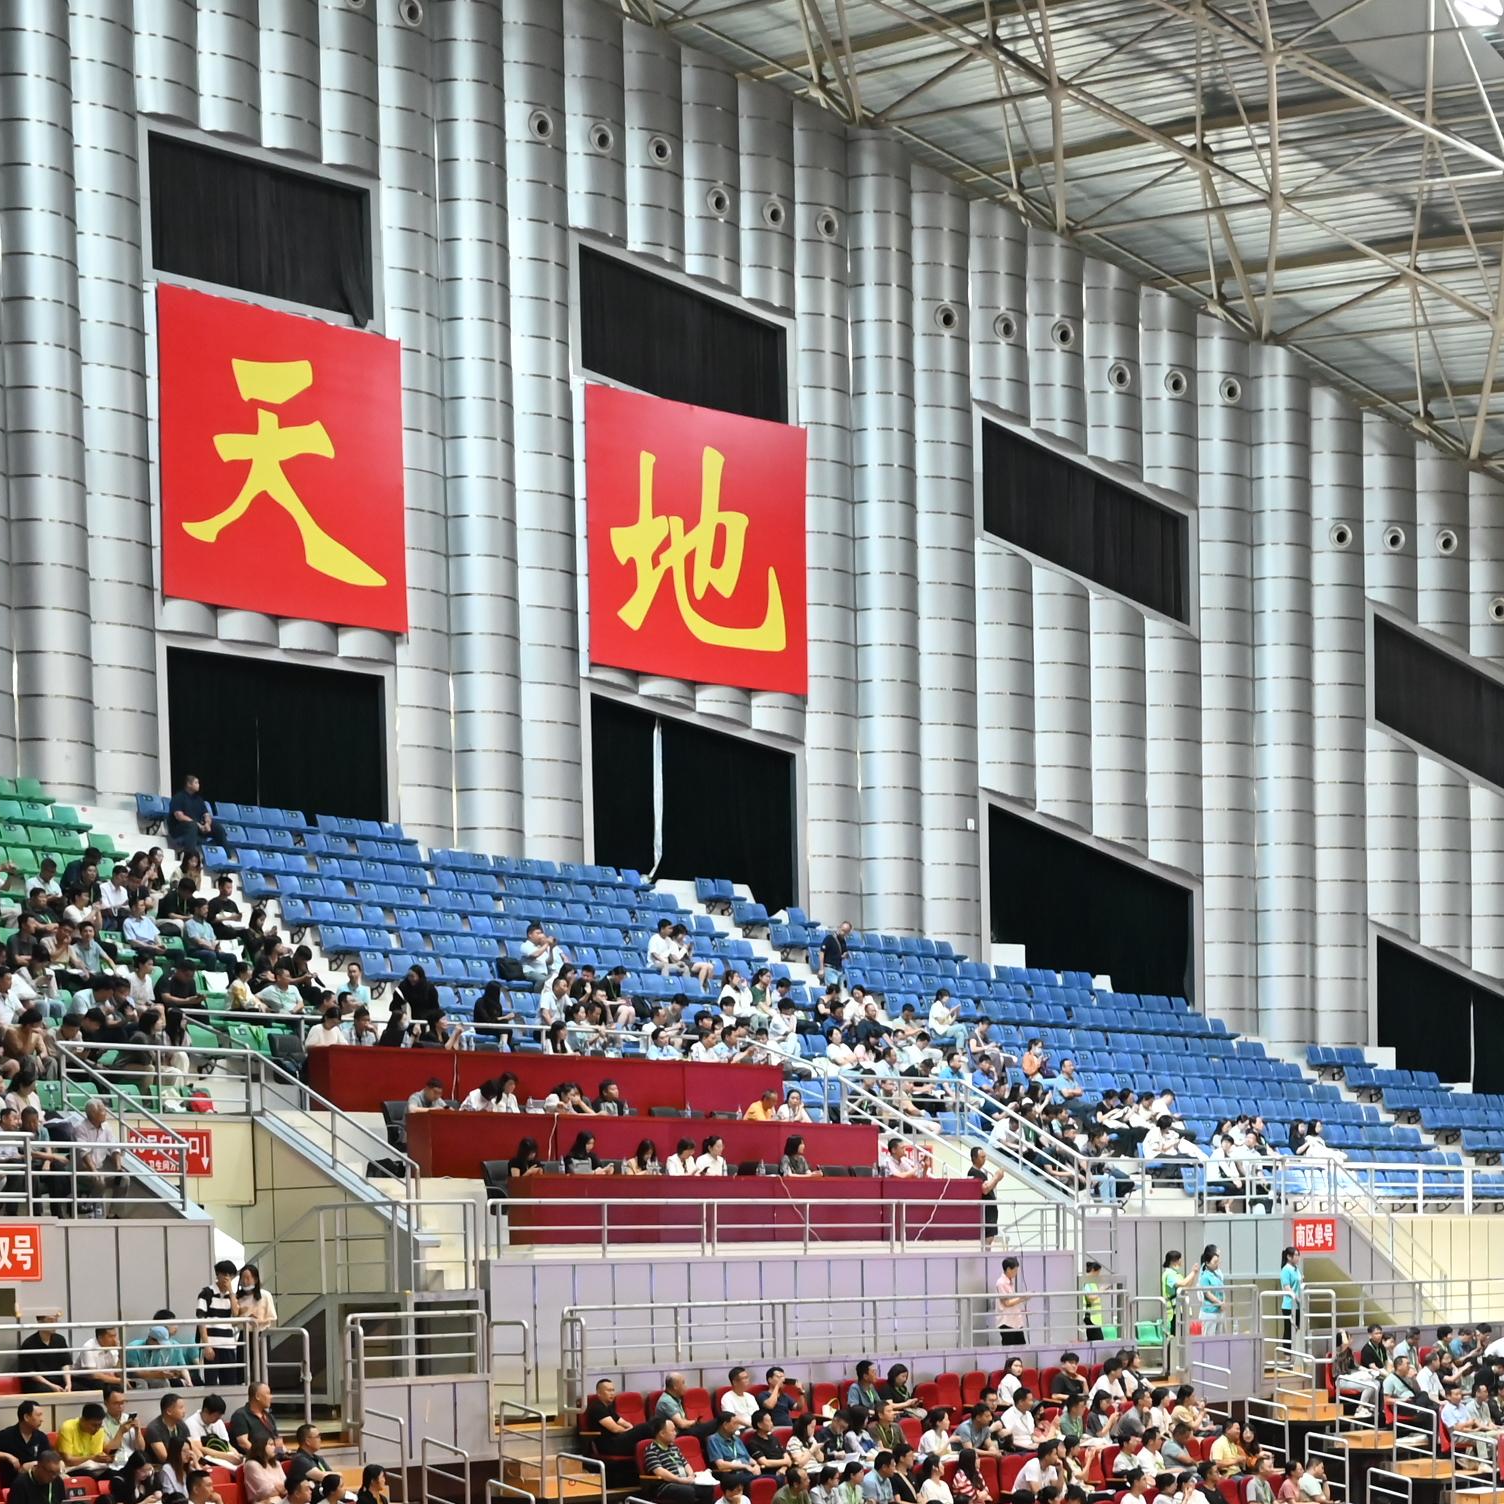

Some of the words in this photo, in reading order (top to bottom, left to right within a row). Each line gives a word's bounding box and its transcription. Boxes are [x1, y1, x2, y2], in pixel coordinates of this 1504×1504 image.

[181, 357, 388, 588] 天
[609, 445, 787, 652] 地
[1295, 1222, 1334, 1248] 南区单号
